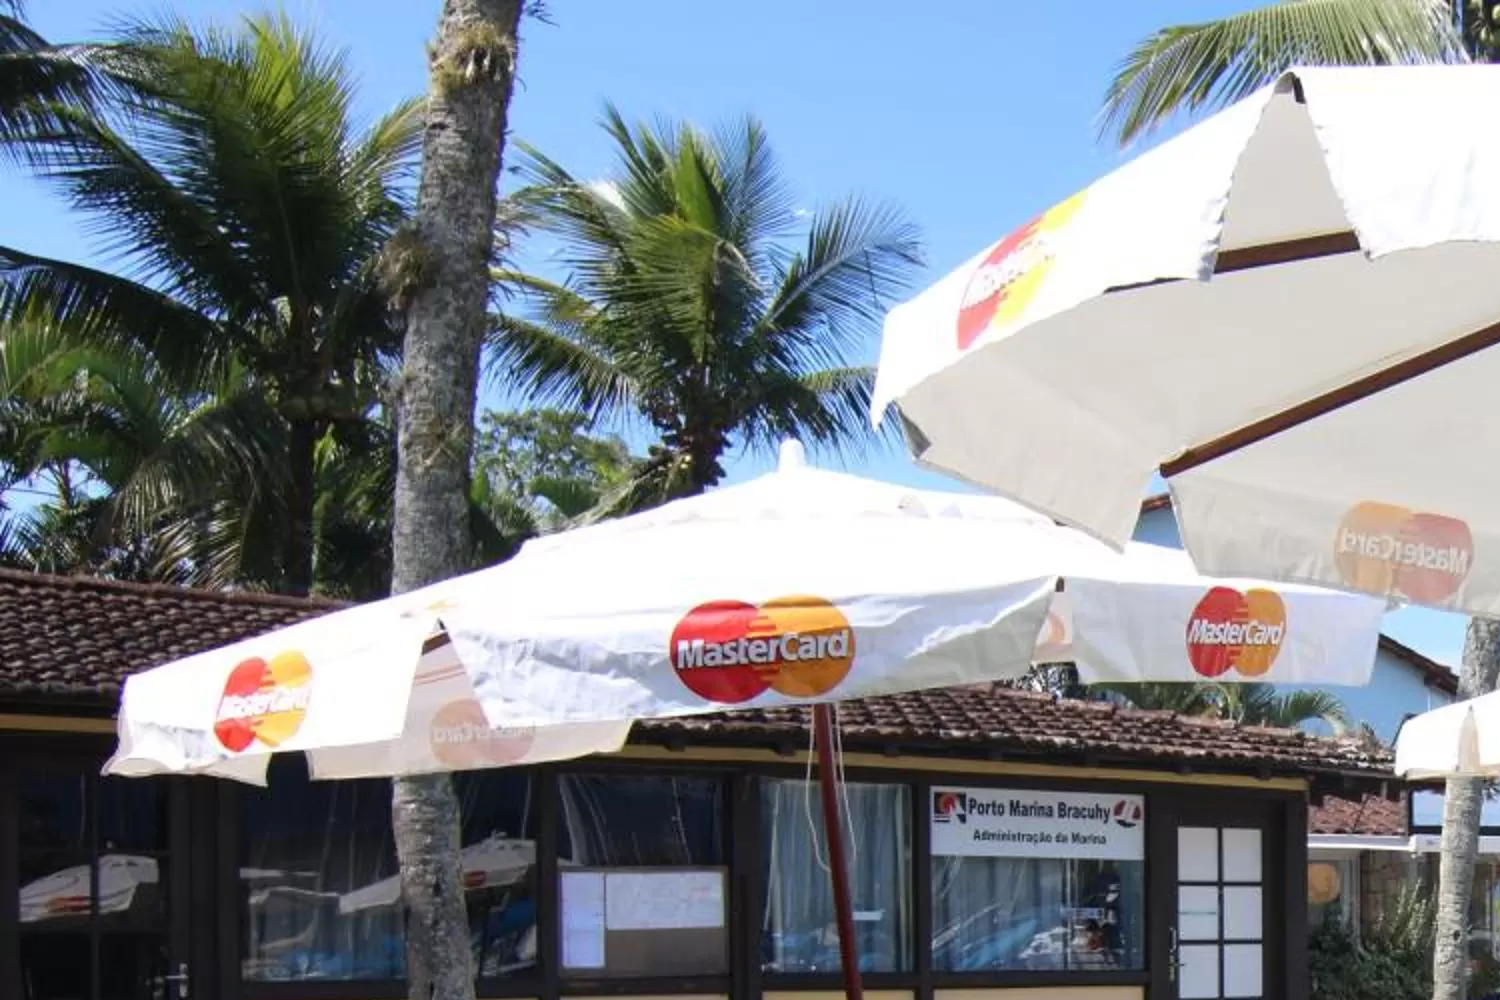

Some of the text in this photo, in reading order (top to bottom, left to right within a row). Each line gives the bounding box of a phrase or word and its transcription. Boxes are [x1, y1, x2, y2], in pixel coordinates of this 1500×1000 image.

[1187, 618, 1284, 645] MasterCard
[676, 629, 849, 670] MasterCard
[968, 798, 1111, 823] Porto Marina Bracuhy
[973, 829, 1106, 846] Administração da Marina
